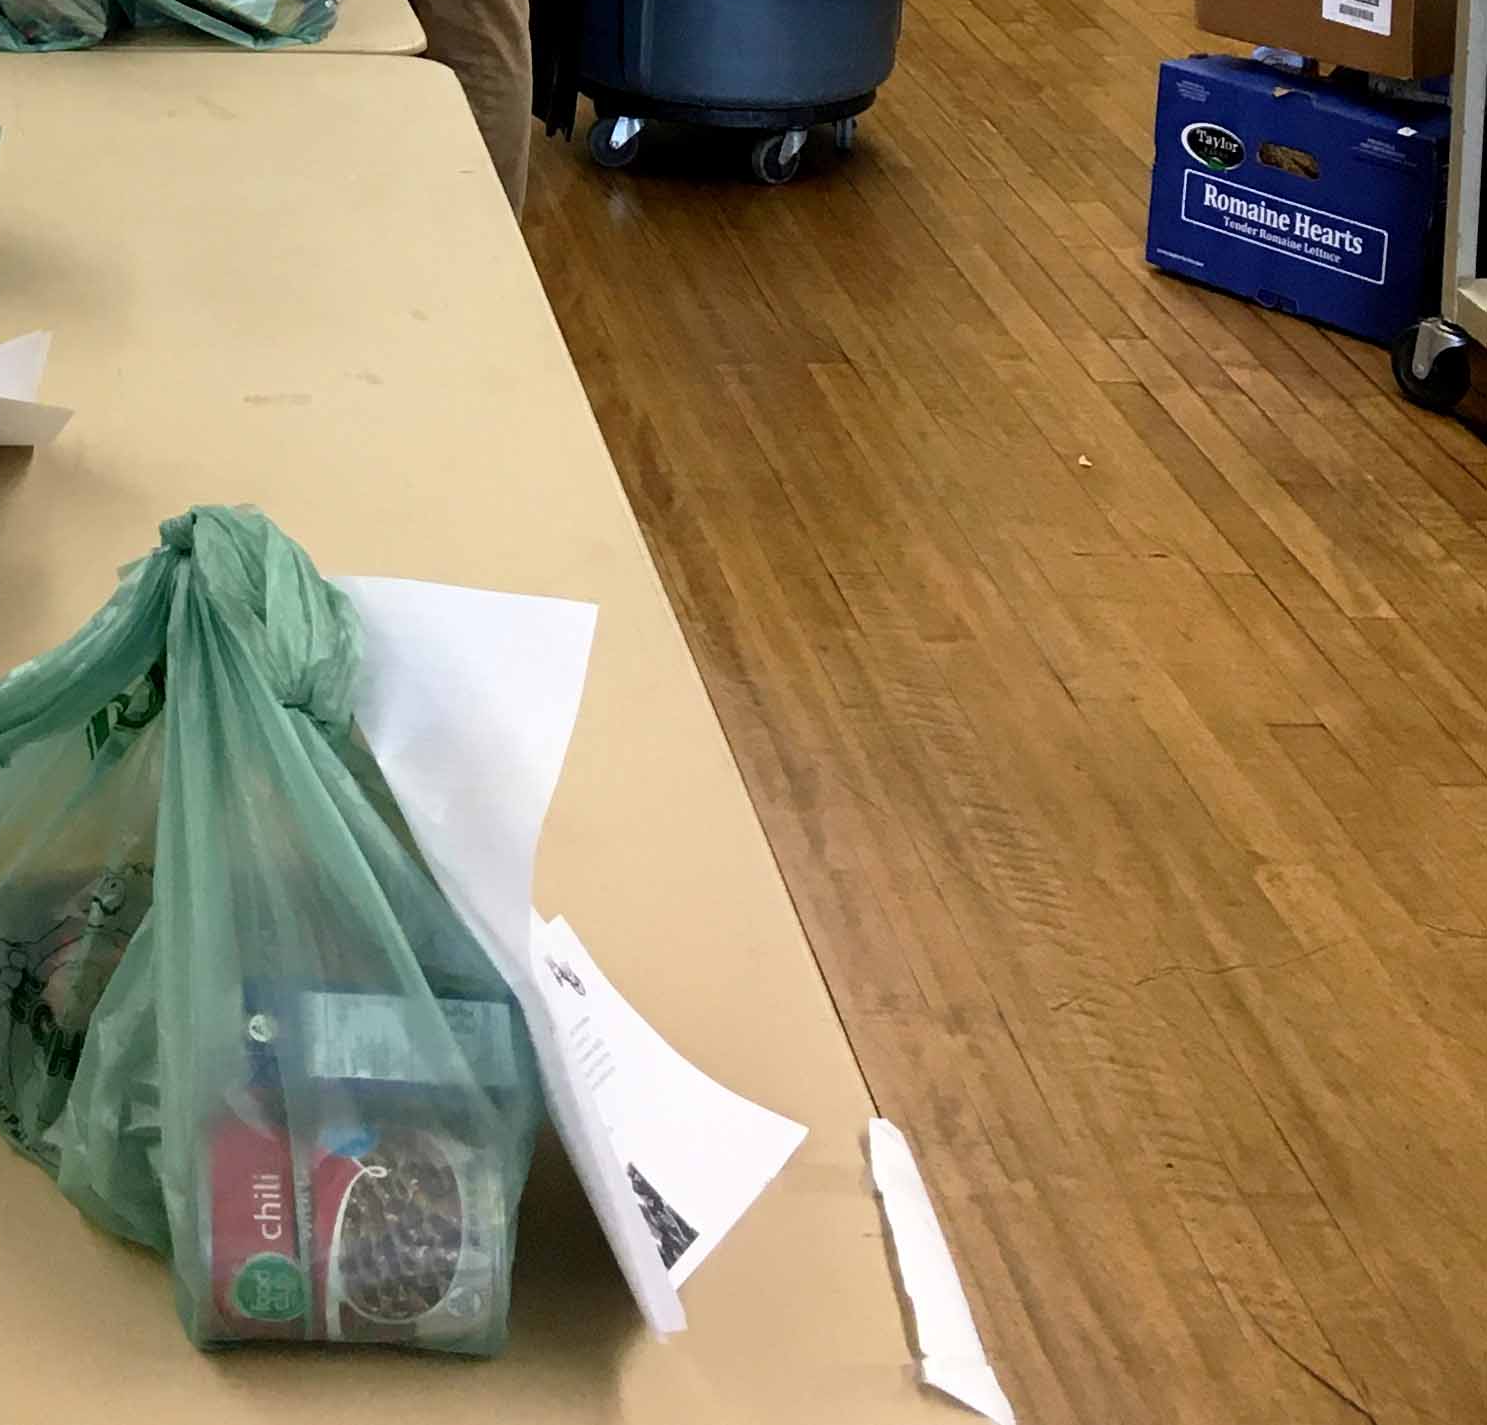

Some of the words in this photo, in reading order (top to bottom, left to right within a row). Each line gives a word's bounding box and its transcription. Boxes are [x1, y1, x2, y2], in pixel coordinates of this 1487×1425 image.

[1196, 128, 1239, 154] Taylor
[1203, 183, 1291, 231] Romaine
[1294, 212, 1363, 255] Hearts
[1223, 216, 1258, 236] Tender
[1259, 228, 1303, 252] Romaine
[252, 1174, 282, 1241] chili
